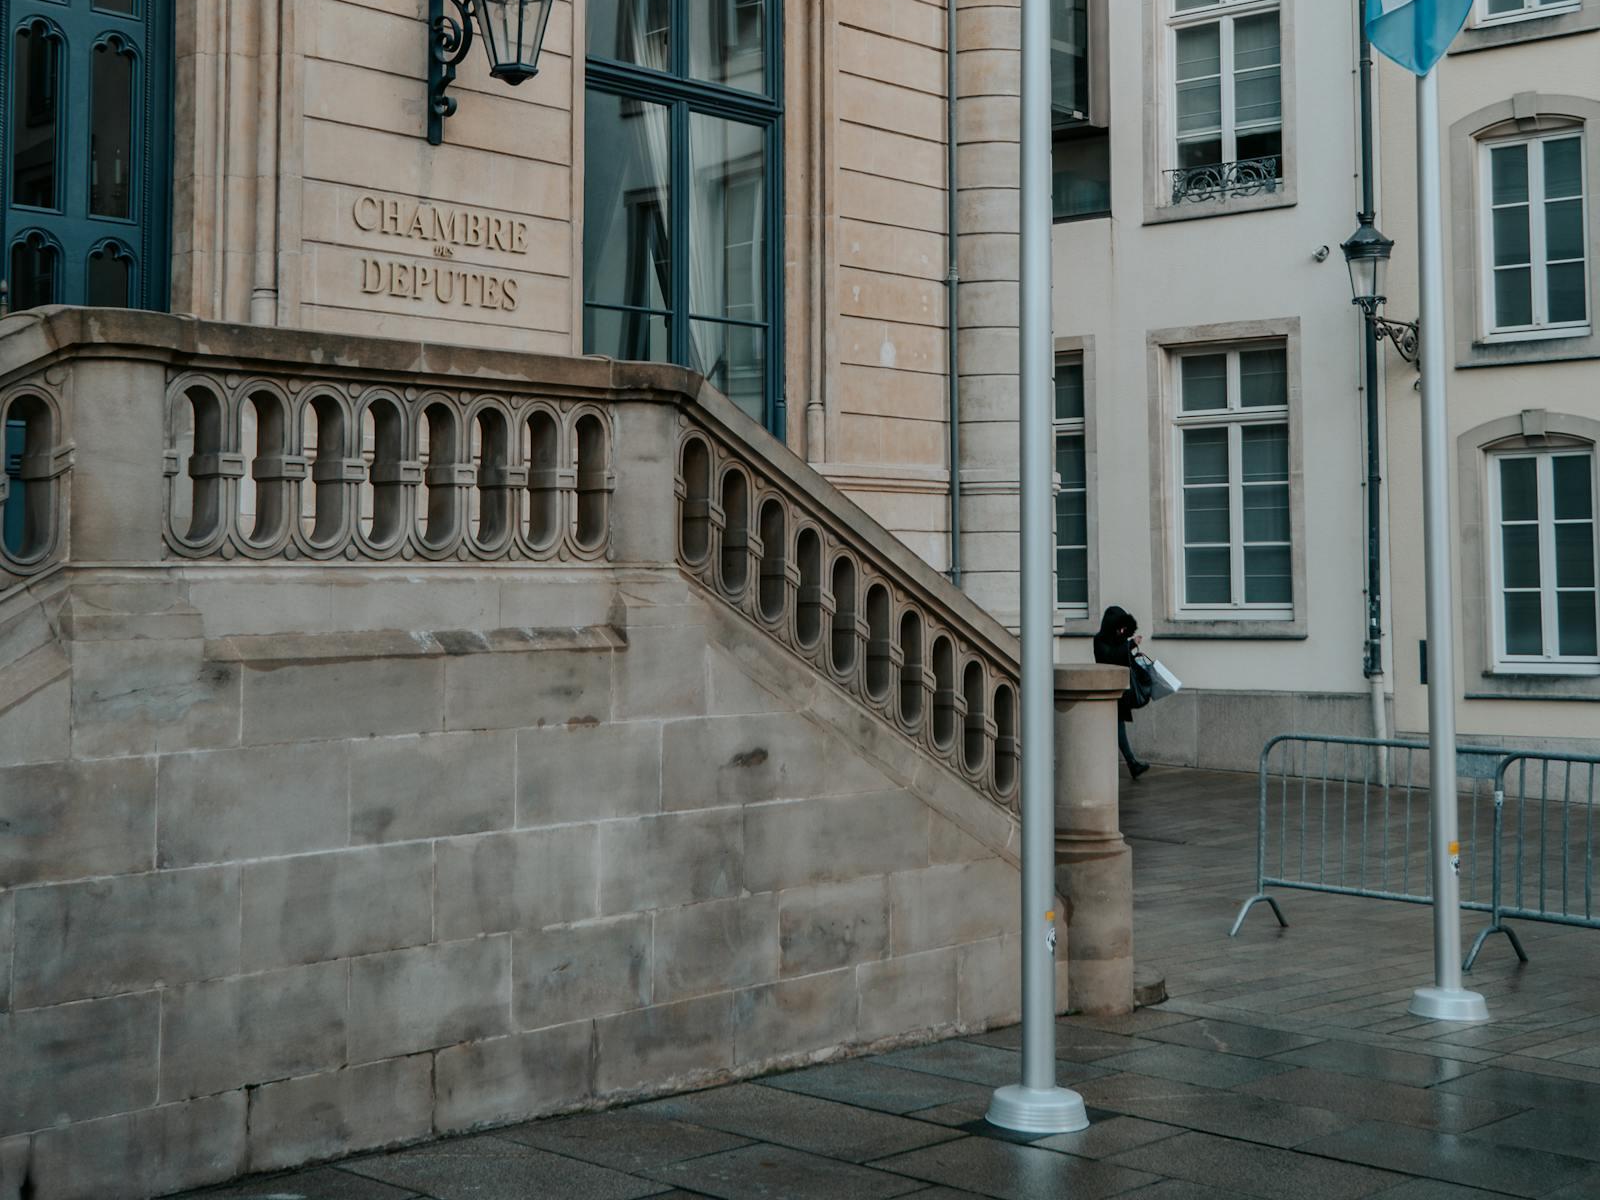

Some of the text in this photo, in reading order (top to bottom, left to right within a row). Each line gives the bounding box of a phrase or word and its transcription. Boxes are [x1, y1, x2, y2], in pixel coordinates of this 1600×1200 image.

[353, 196, 528, 254] CHAMBRE
[432, 244, 455, 258] DES
[360, 257, 519, 311] DEPUTES
